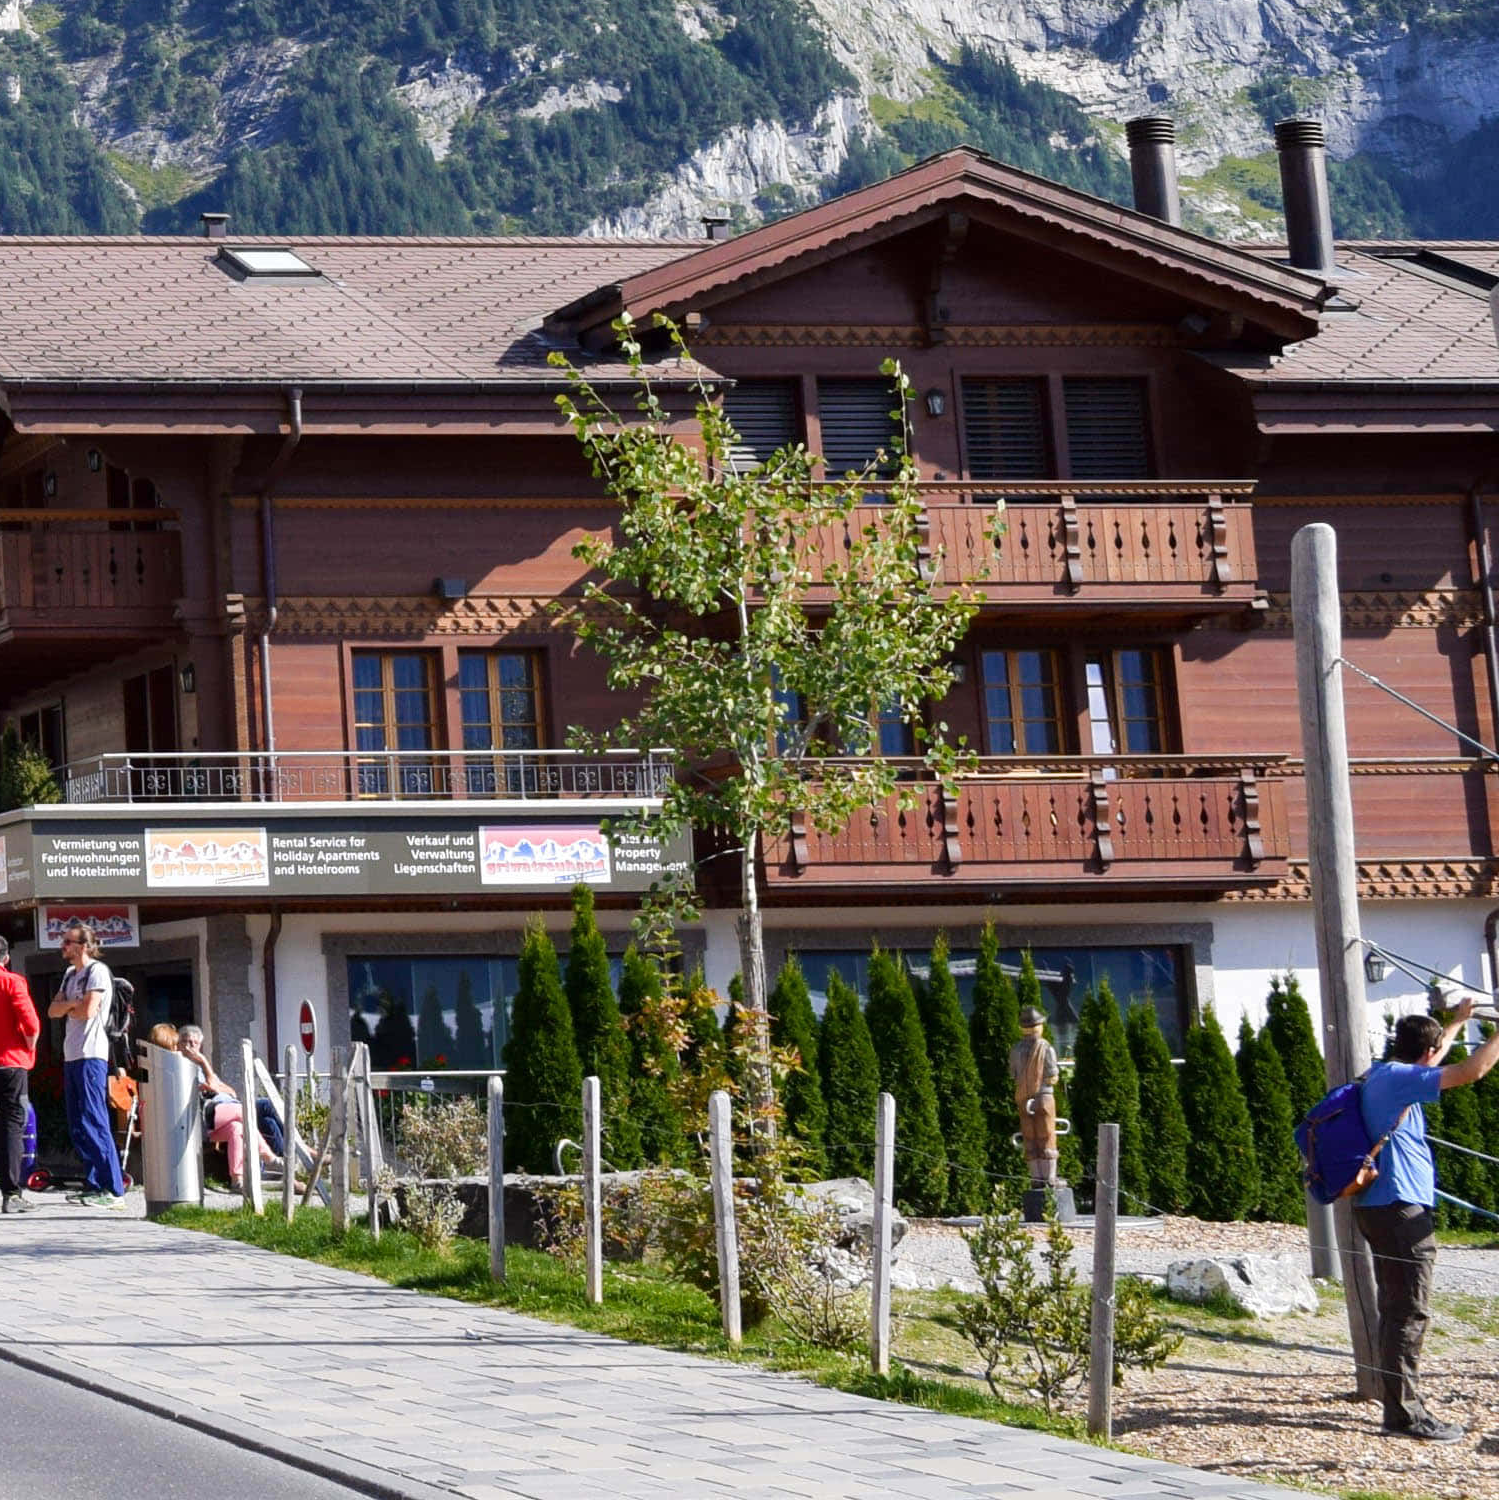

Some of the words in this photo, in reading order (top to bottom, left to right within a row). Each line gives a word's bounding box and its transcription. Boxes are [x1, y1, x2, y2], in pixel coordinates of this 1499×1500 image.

[53, 839, 116, 853] Vermietung
[119, 841, 140, 850] von
[273, 837, 307, 848] Rental
[309, 837, 347, 848] Service
[349, 837, 366, 848] for
[406, 835, 450, 846] Verkauf
[453, 835, 474, 846] und
[42, 852, 140, 866] Ferienwohnungen
[274, 851, 314, 863] Holiday
[317, 851, 380, 863] Apartments
[411, 849, 475, 862] Verwaltung
[615, 847, 661, 860] Property
[47, 866, 67, 877] und
[71, 866, 141, 877] Hotelzimmer
[274, 864, 295, 875] and
[298, 864, 360, 875] Hotelrooms
[394, 863, 476, 877] Liegenschaften
